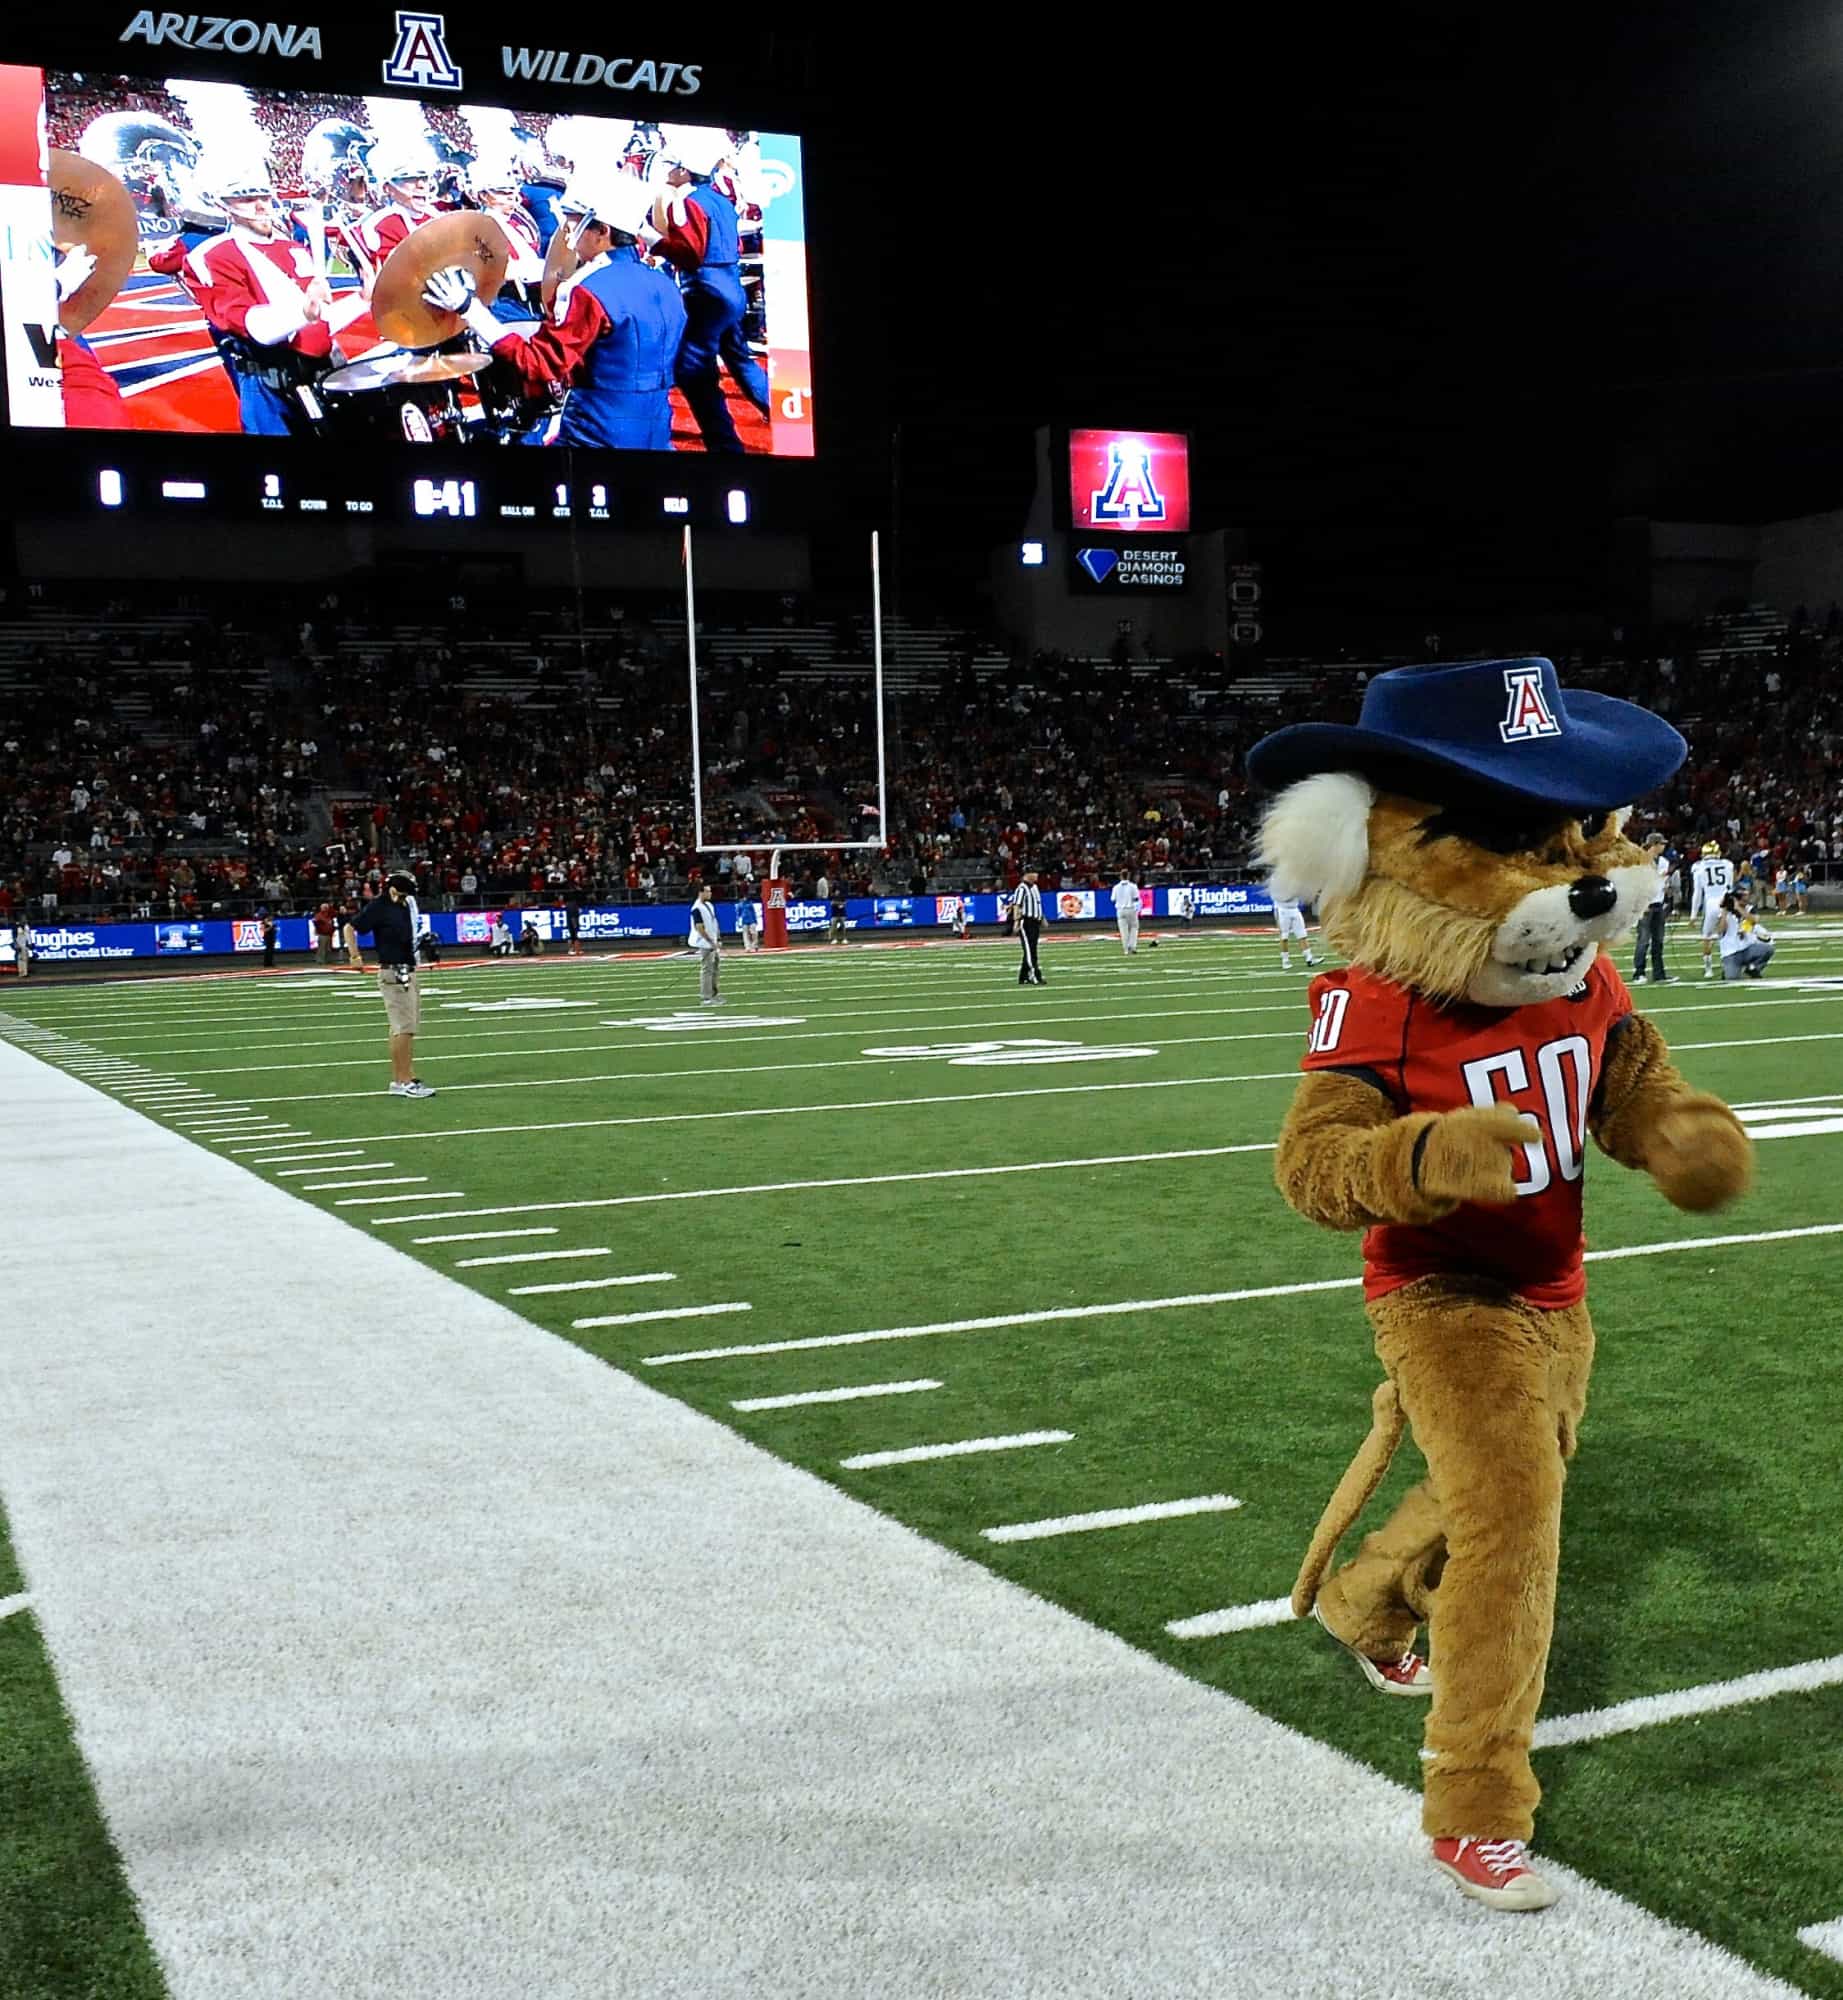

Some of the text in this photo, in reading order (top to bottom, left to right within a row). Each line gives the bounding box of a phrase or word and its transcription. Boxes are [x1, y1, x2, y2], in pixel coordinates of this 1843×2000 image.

[119, 10, 322, 60] ARIZONA
[382, 10, 463, 90] A
[502, 46, 702, 95] WILDCATS
[1091, 440, 1166, 523] A
[1123, 550, 1178, 562] DESERT
[1117, 561, 1185, 574] DIAMOND
[1119, 573, 1184, 585] CASINOS
[1500, 667, 1561, 742] A
[1706, 867, 1726, 887] 15
[768, 887, 787, 909] A
[1193, 888, 1247, 906] Hughes
[785, 902, 826, 922] ghes
[1200, 904, 1227, 914] Federal
[552, 910, 619, 930] Hghes
[1463, 1035, 1592, 1197] 50
